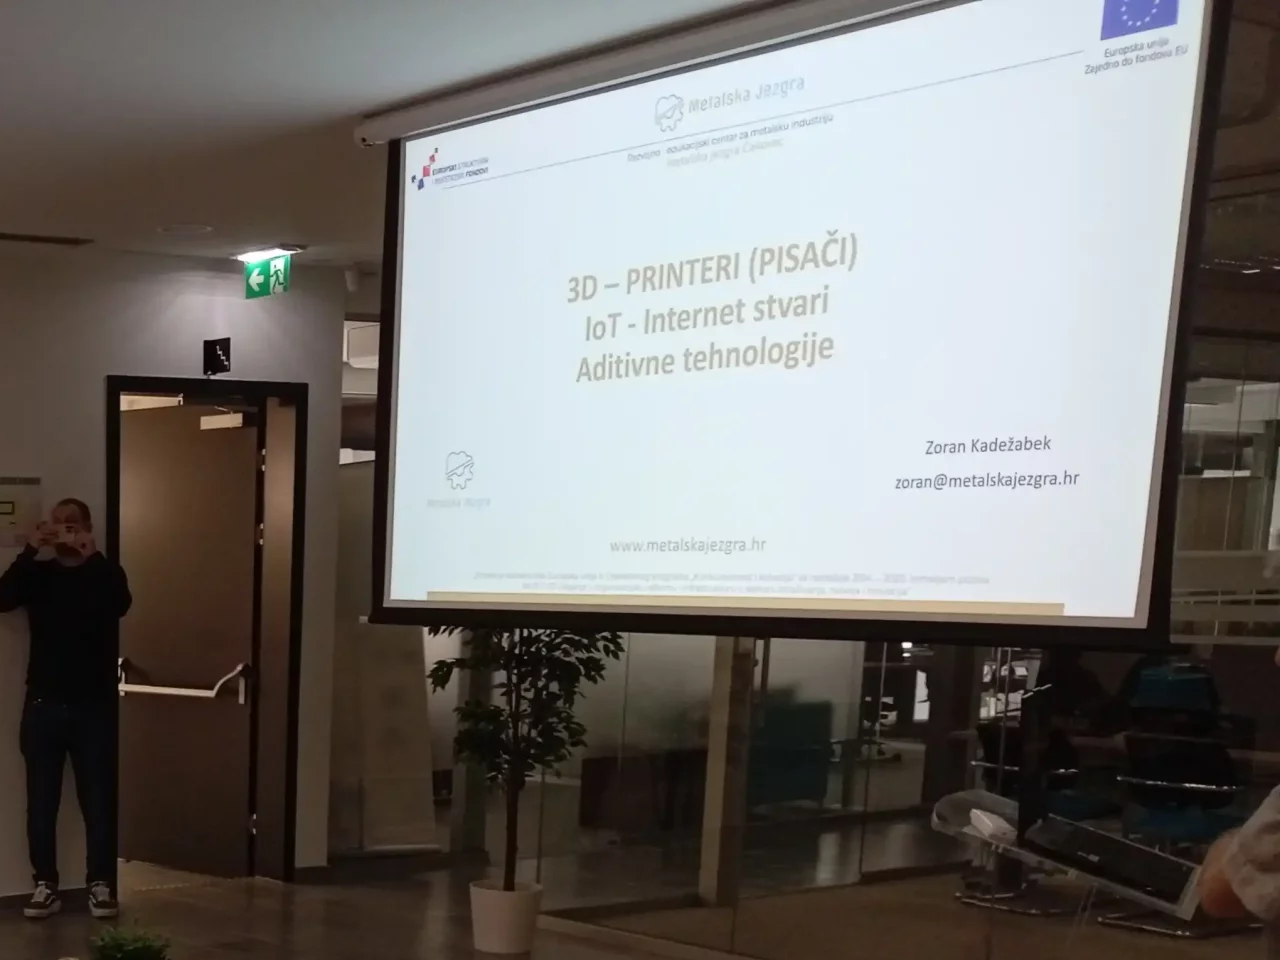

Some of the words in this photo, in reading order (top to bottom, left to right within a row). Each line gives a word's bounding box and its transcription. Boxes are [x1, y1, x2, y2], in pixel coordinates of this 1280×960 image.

[1104, 42, 1144, 58] Europska
[567, 274, 598, 303] 3D
[626, 252, 741, 295] PRINTERI
[748, 229, 857, 285] (PISAČI)
[585, 312, 622, 342] IoT
[643, 298, 746, 335] Internet
[753, 284, 830, 323] stvari
[575, 351, 675, 383] Aditivne
[683, 332, 835, 373] tehnologije
[925, 438, 966, 455] Zoran
[971, 435, 1052, 454] Kadežabek
[895, 470, 1080, 491] zoran@metalskajezgra.hr
[609, 537, 767, 556] www.metalskajezgra.hr
